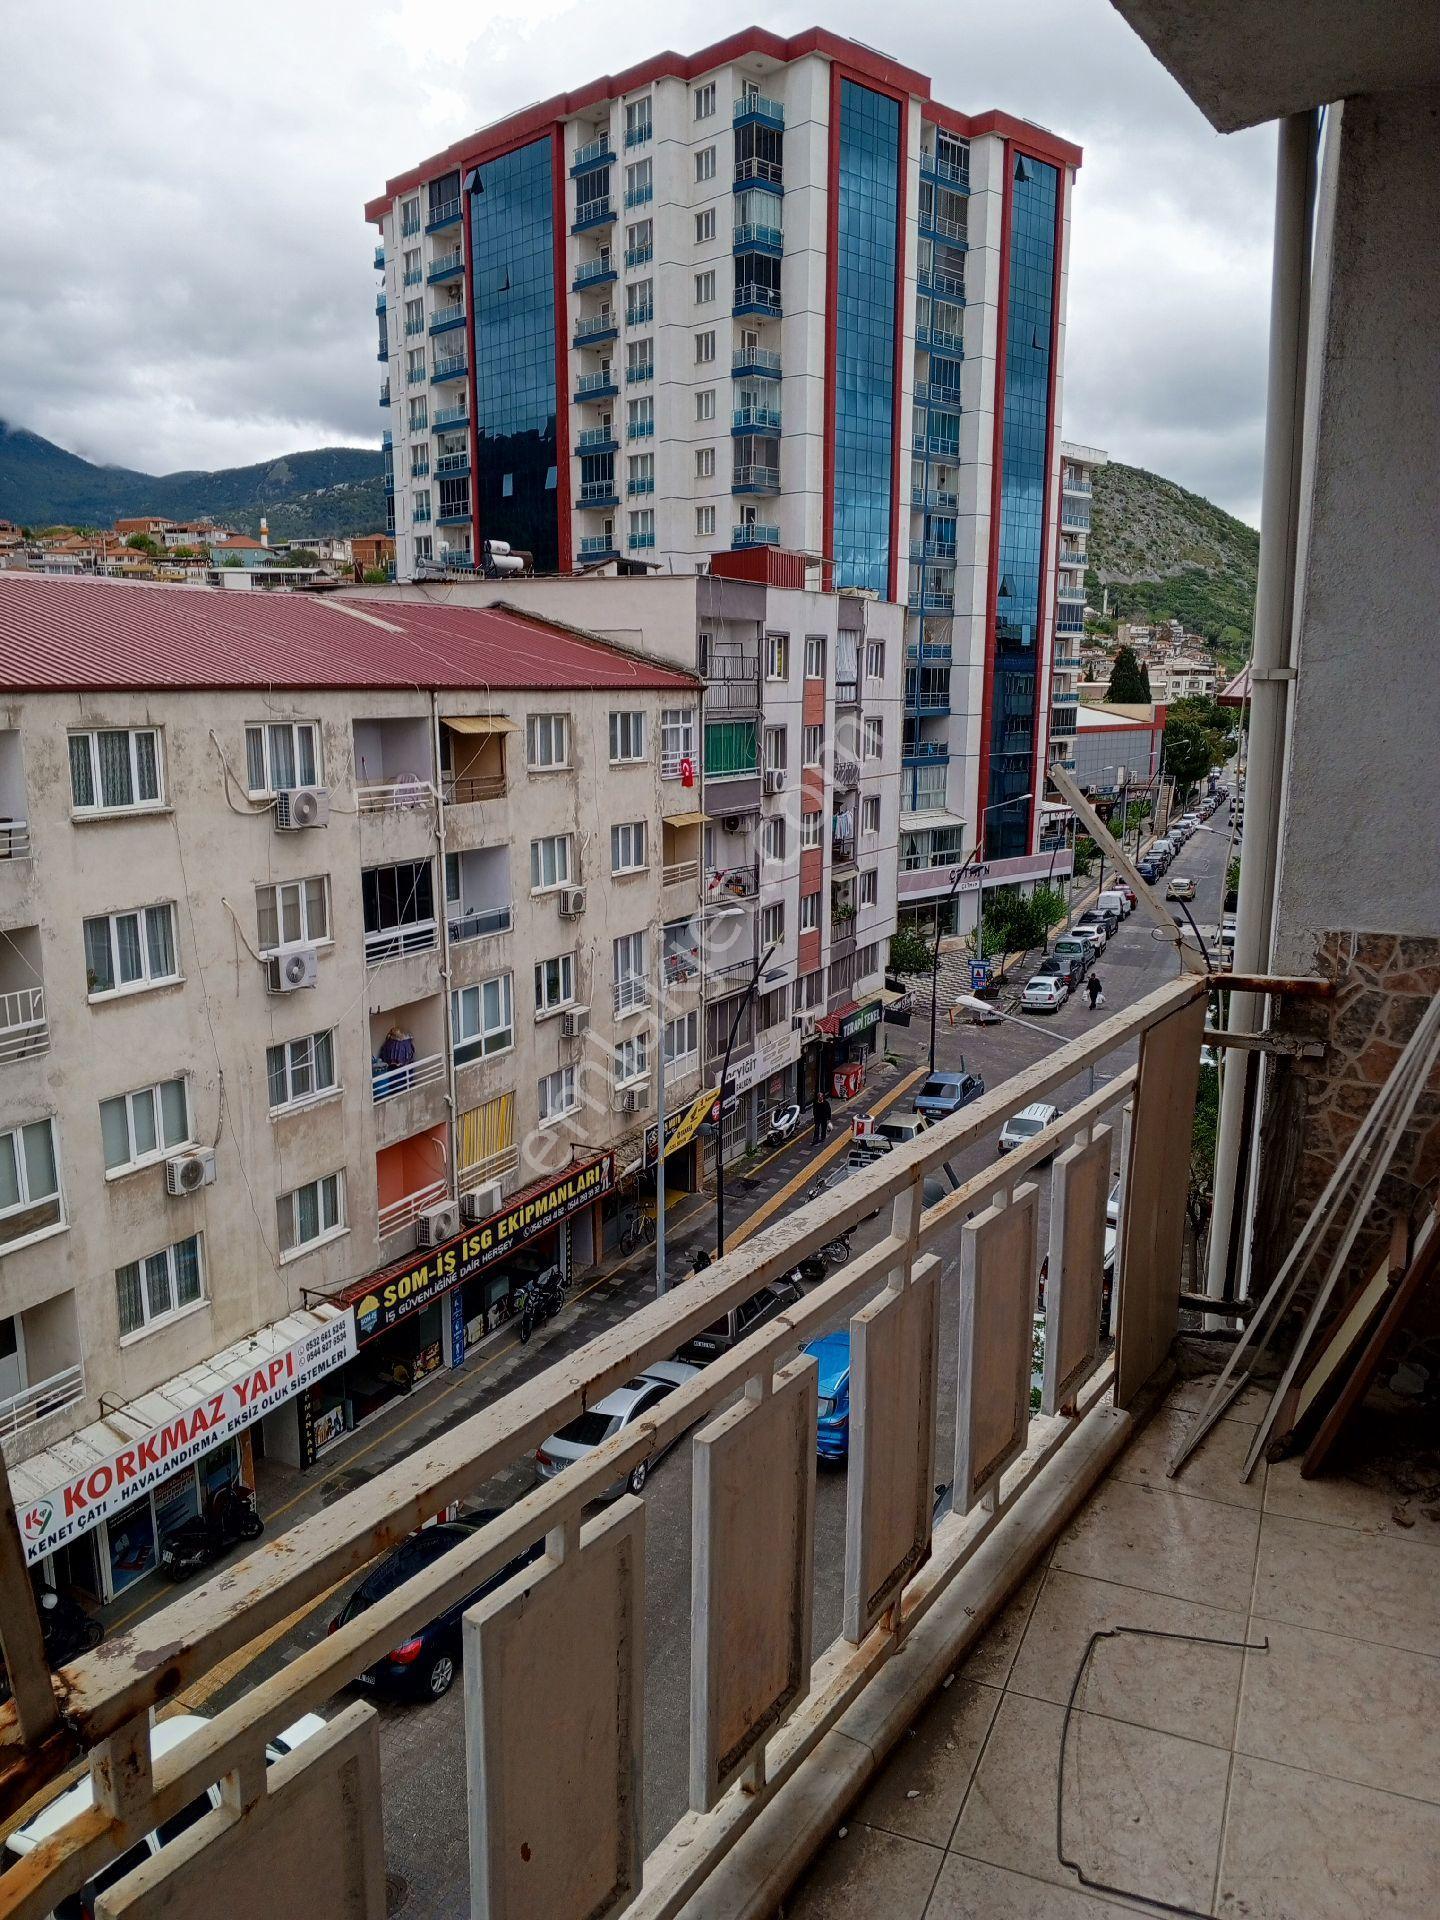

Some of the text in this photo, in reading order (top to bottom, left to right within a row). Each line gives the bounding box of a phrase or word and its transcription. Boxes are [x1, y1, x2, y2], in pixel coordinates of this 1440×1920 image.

[383, 1165, 600, 1308] SOM-İŞ İSG EKİPMANLARI
[385, 1237, 514, 1323] İŞ GÜVENLİĞİNE DAİR HERŞEY
[305, 1336, 320, 1351] 0532
[28, 1522, 74, 1560] KENET
[77, 1501, 107, 1531] ÇATI
[121, 1431, 219, 1500] HAVALANDIRMA
[227, 1405, 259, 1432] EKSİZ
[262, 1385, 289, 1409] OLUK
[290, 1344, 347, 1391] SİSTEMLERİ
[63, 1351, 294, 1518] KORKMAZ YAPI
